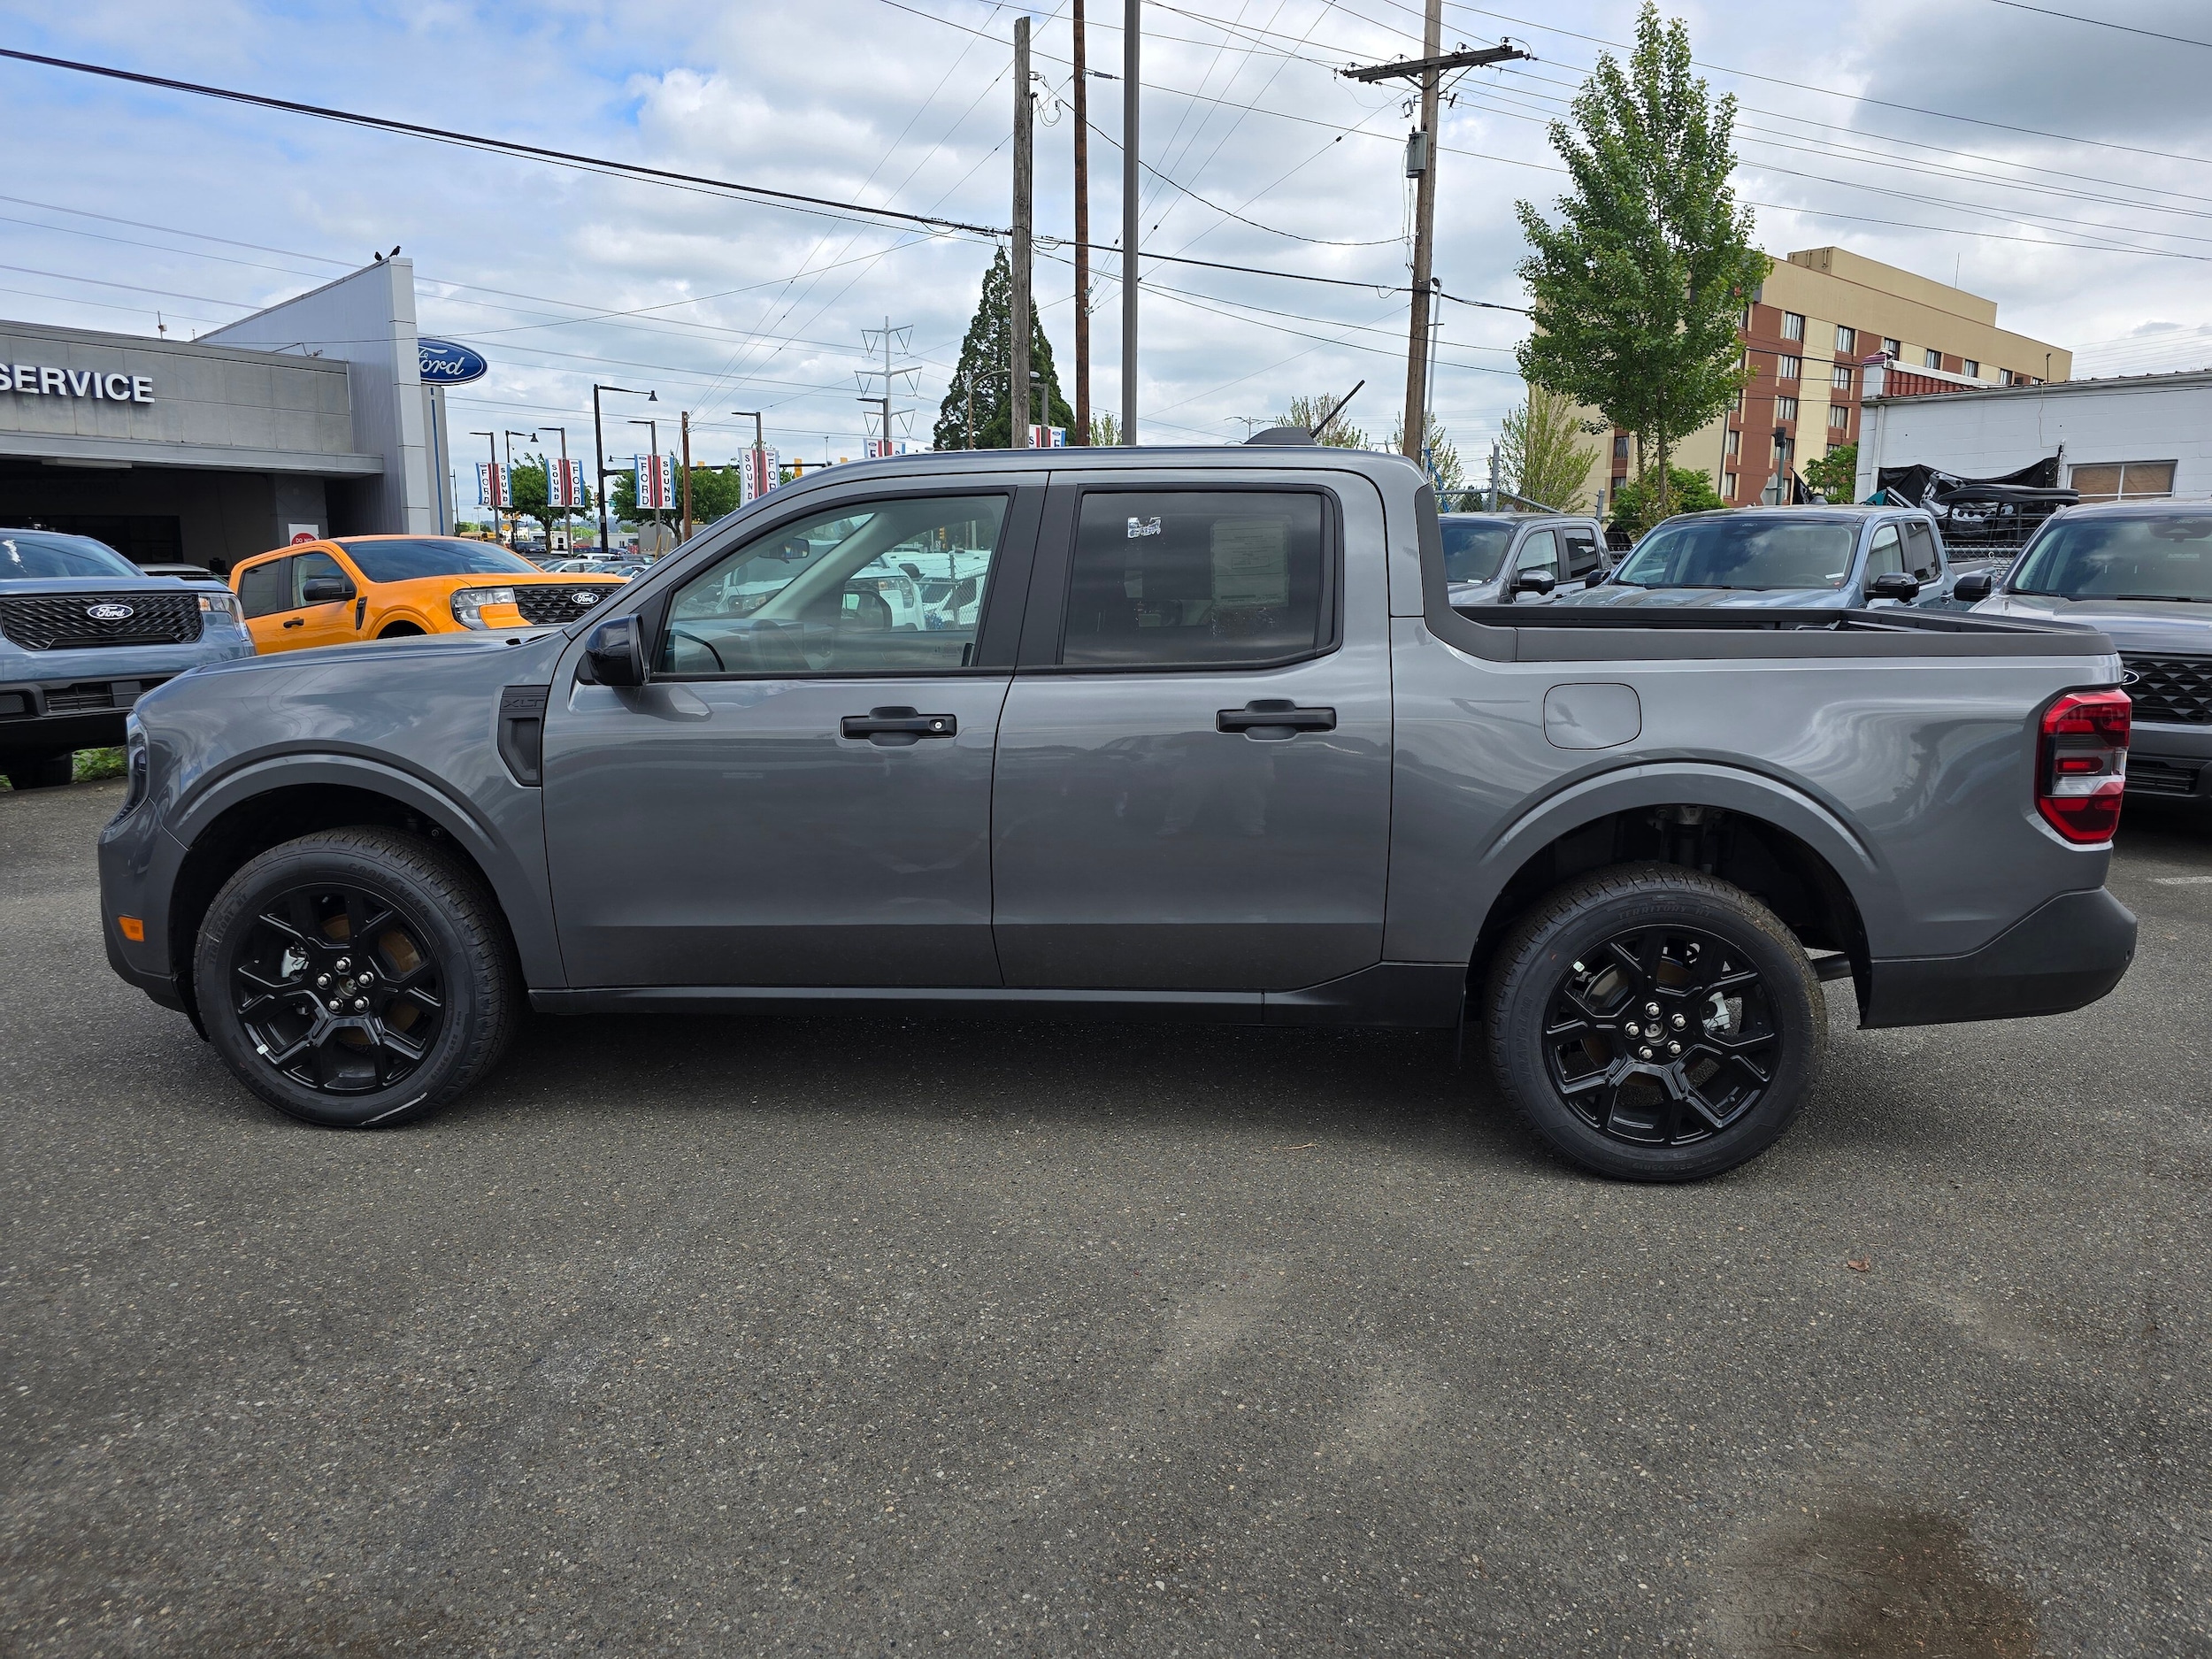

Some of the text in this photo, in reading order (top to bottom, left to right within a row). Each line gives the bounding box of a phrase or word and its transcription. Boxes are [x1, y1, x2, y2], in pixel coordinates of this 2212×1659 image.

[0, 362, 155, 403] SERVICE
[481, 469, 490, 504] FORD
[500, 467, 509, 502] SOUND
[551, 465, 560, 500] SOUND
[641, 463, 649, 505] FORD
[767, 458, 777, 491] FOR
[96, 606, 125, 618] Ford
[503, 699, 545, 708] XLT
